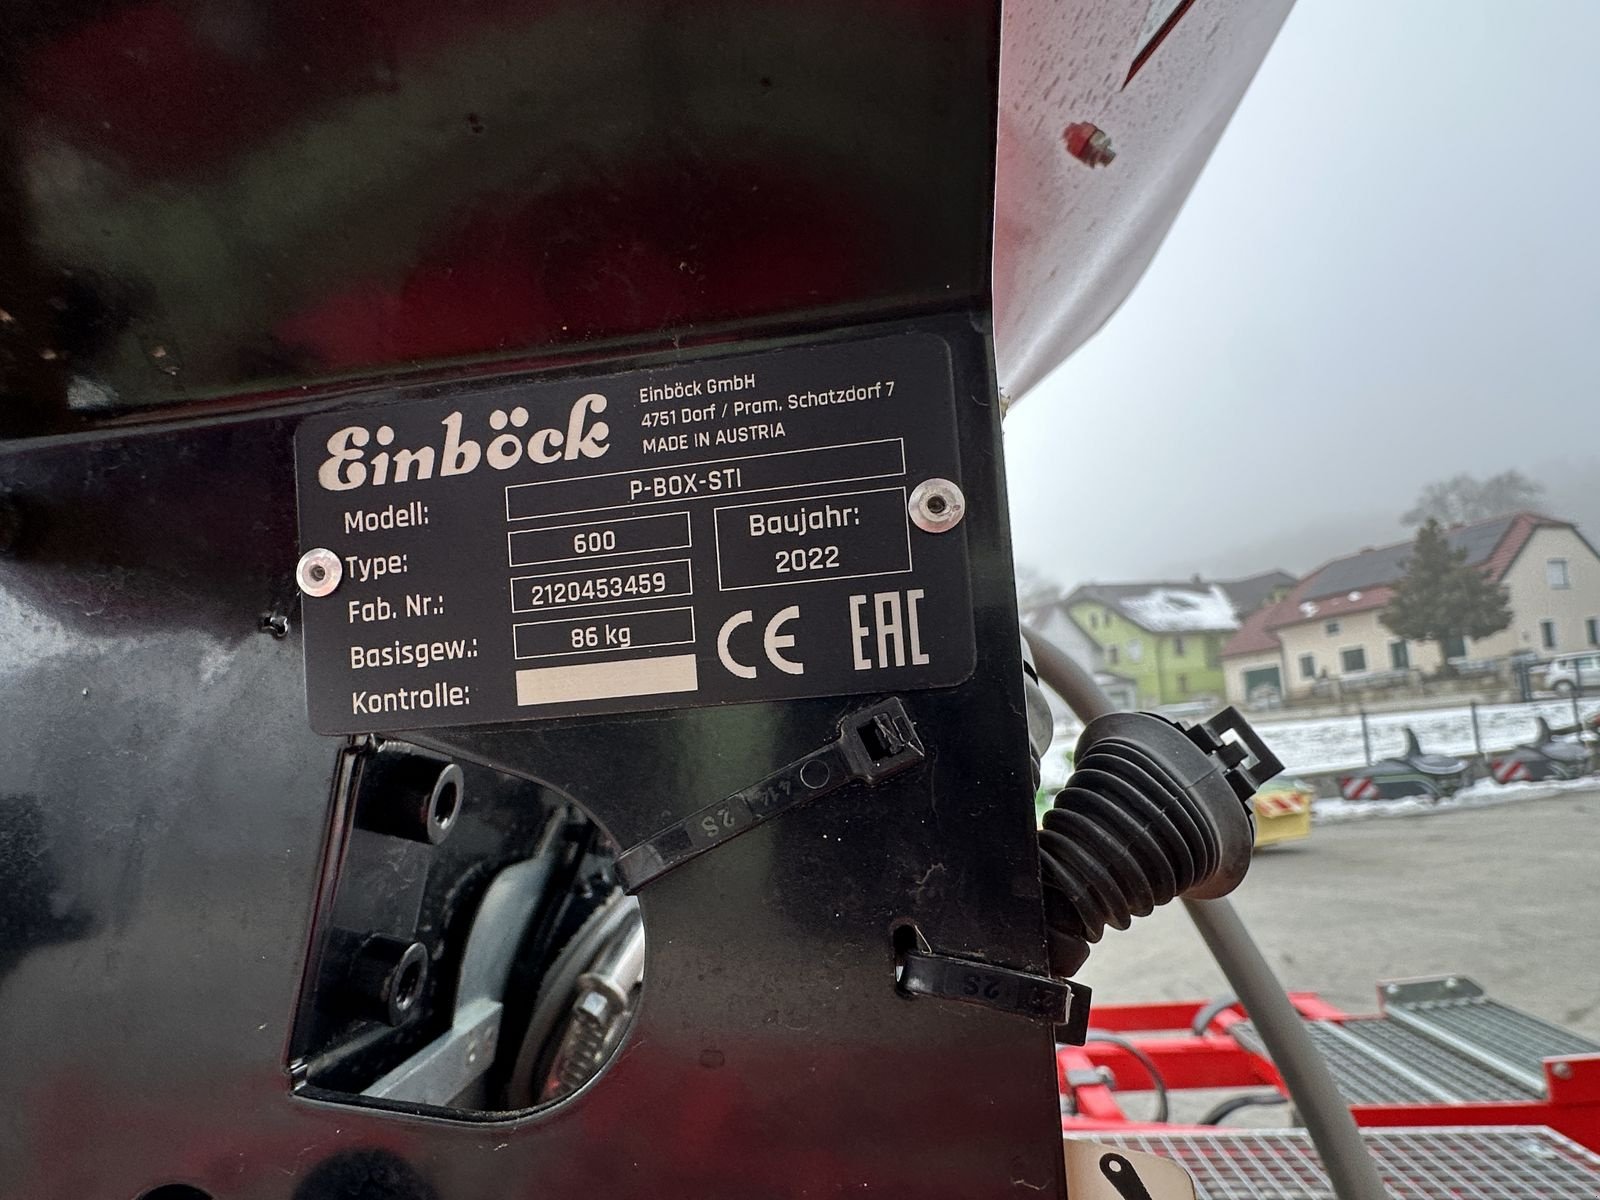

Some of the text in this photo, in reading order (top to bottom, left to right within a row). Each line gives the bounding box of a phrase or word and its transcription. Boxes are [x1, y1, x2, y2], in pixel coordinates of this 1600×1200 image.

[638, 374, 756, 404] Einböck GmbH
[641, 381, 895, 428] 4751 Dorf / Pram. Schatzdorf 7
[318, 393, 610, 492] Einböck
[642, 422, 786, 455] MADE IN AUSTRIA
[630, 468, 742, 500] P-BOX-STI
[345, 501, 429, 534] Modell:
[749, 505, 860, 536] Baujahr:
[573, 530, 616, 554] 600
[346, 554, 408, 582] Type:
[775, 546, 840, 573] 2022
[531, 572, 666, 606] 2120453459
[349, 594, 444, 623] Fab. Nr.:
[571, 624, 632, 648] 86 kg
[717, 605, 804, 679] CE
[849, 588, 930, 671] EAC
[351, 638, 478, 669] Basisgew.:
[352, 682, 470, 715] Kontrolle:
